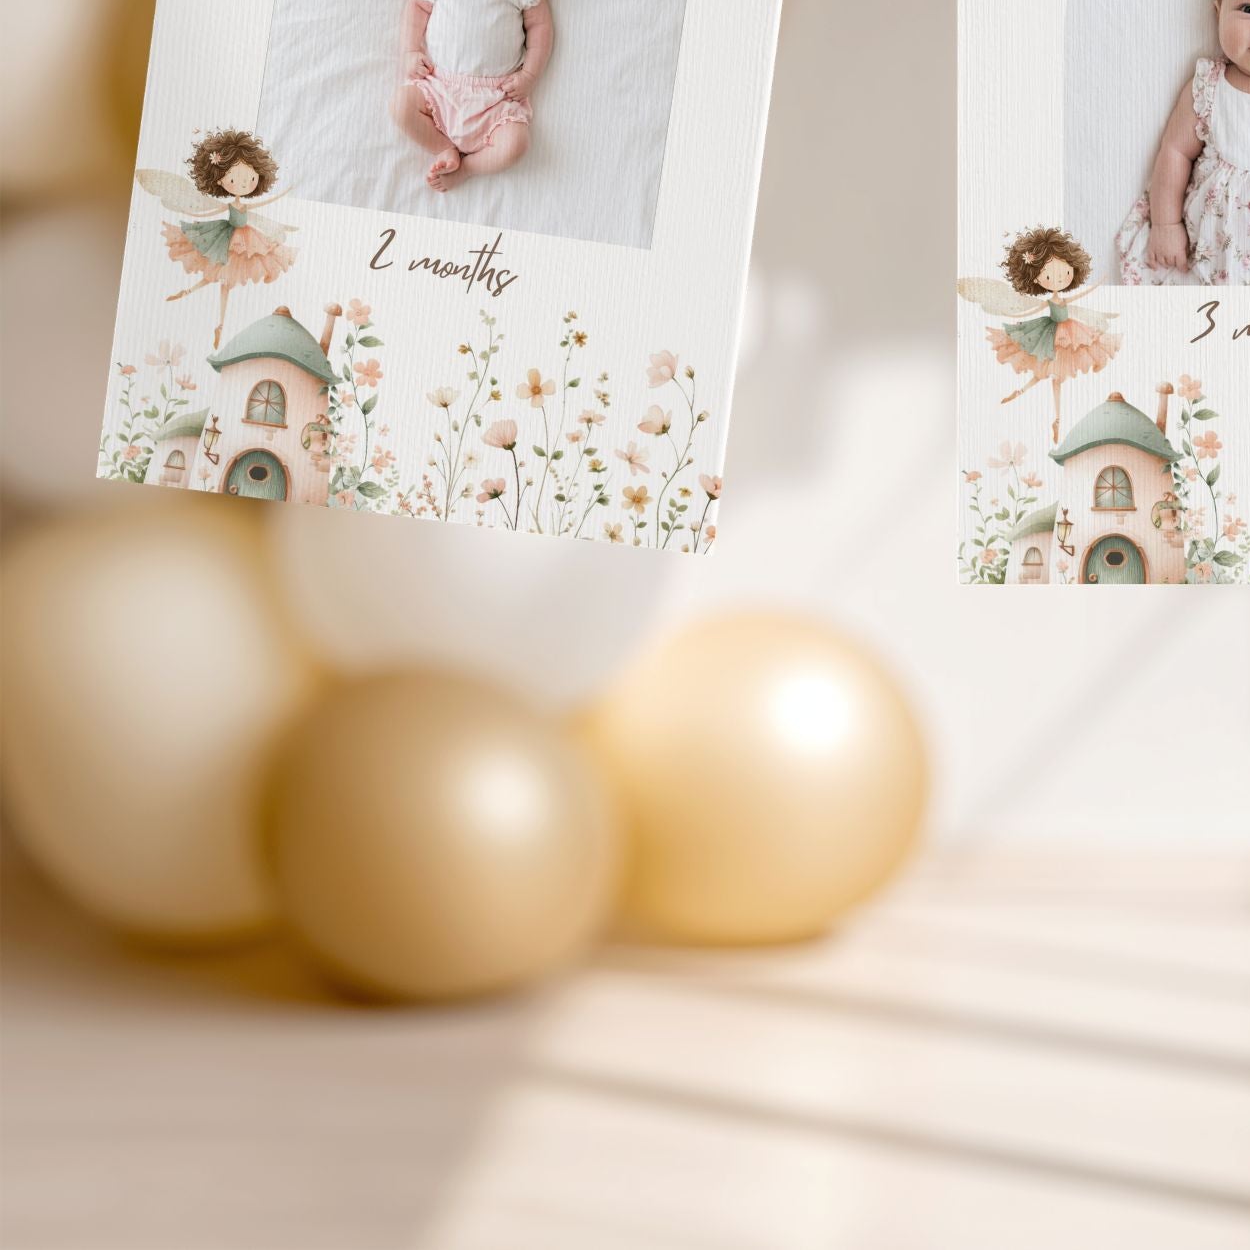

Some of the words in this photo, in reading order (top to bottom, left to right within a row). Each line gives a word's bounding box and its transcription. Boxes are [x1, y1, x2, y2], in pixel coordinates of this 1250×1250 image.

[369, 228, 396, 270] 2
[408, 231, 518, 297] months
[1190, 300, 1220, 344] 3
